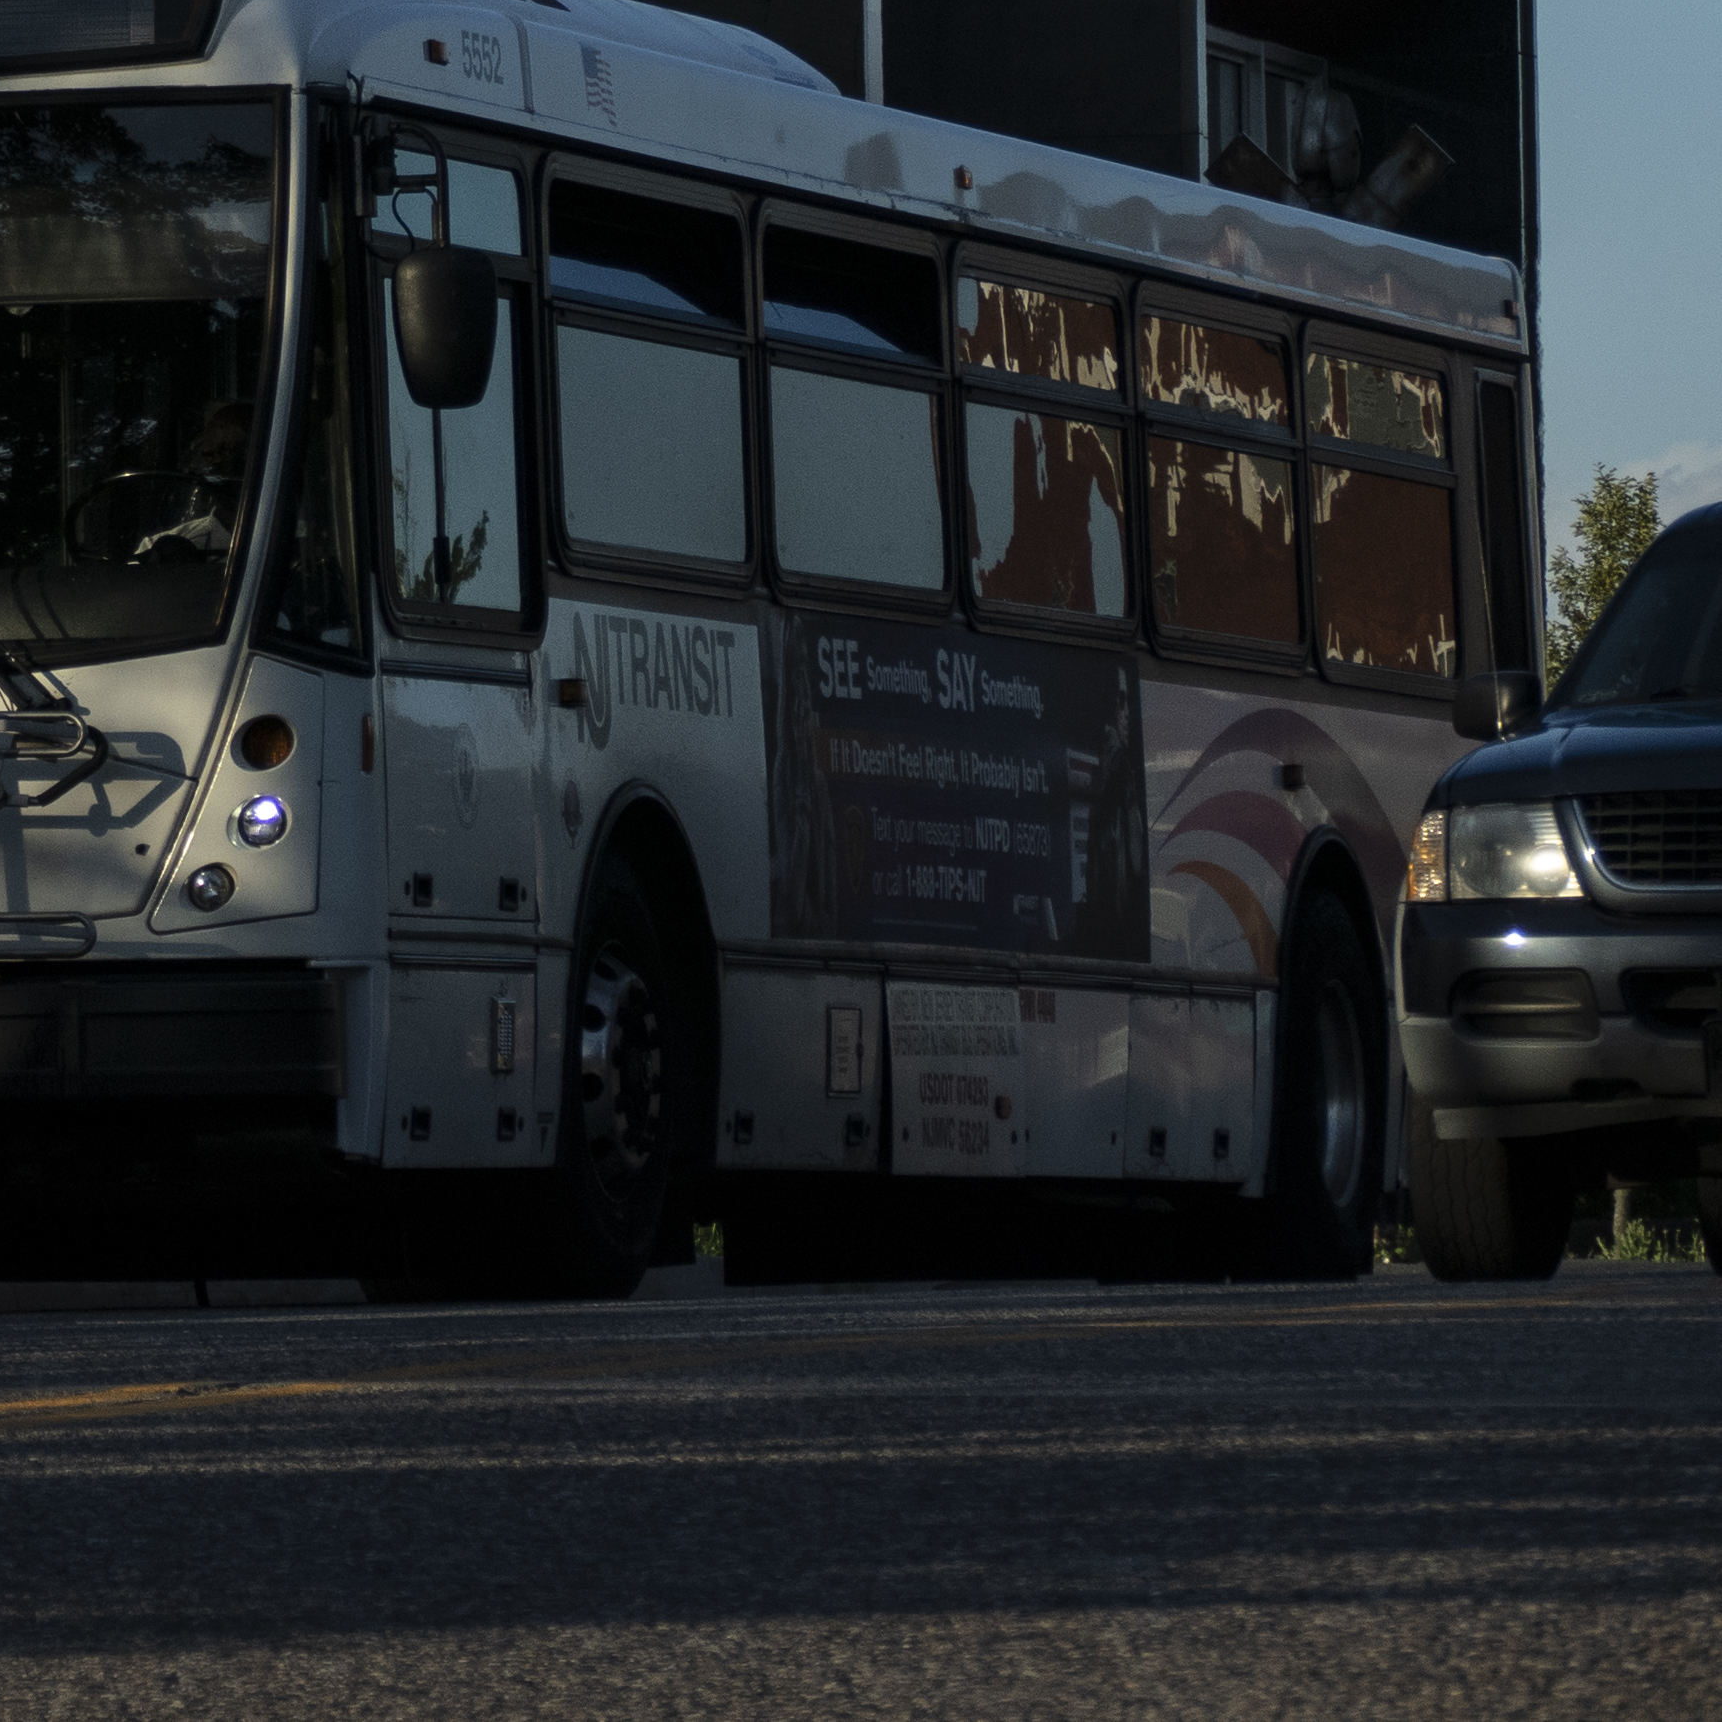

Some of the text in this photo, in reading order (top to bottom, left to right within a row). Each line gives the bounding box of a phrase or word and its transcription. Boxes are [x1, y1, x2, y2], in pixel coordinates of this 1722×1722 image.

[461, 30, 504, 85] 5552
[608, 615, 736, 718] TRANSIT
[817, 635, 1045, 720] SEE Something, SAY Something.
[898, 743, 923, 779] Feel
[971, 751, 1020, 799] Probably
[917, 819, 961, 857] message
[975, 816, 1011, 854] NJTPD
[918, 1072, 954, 1106] USDOT
